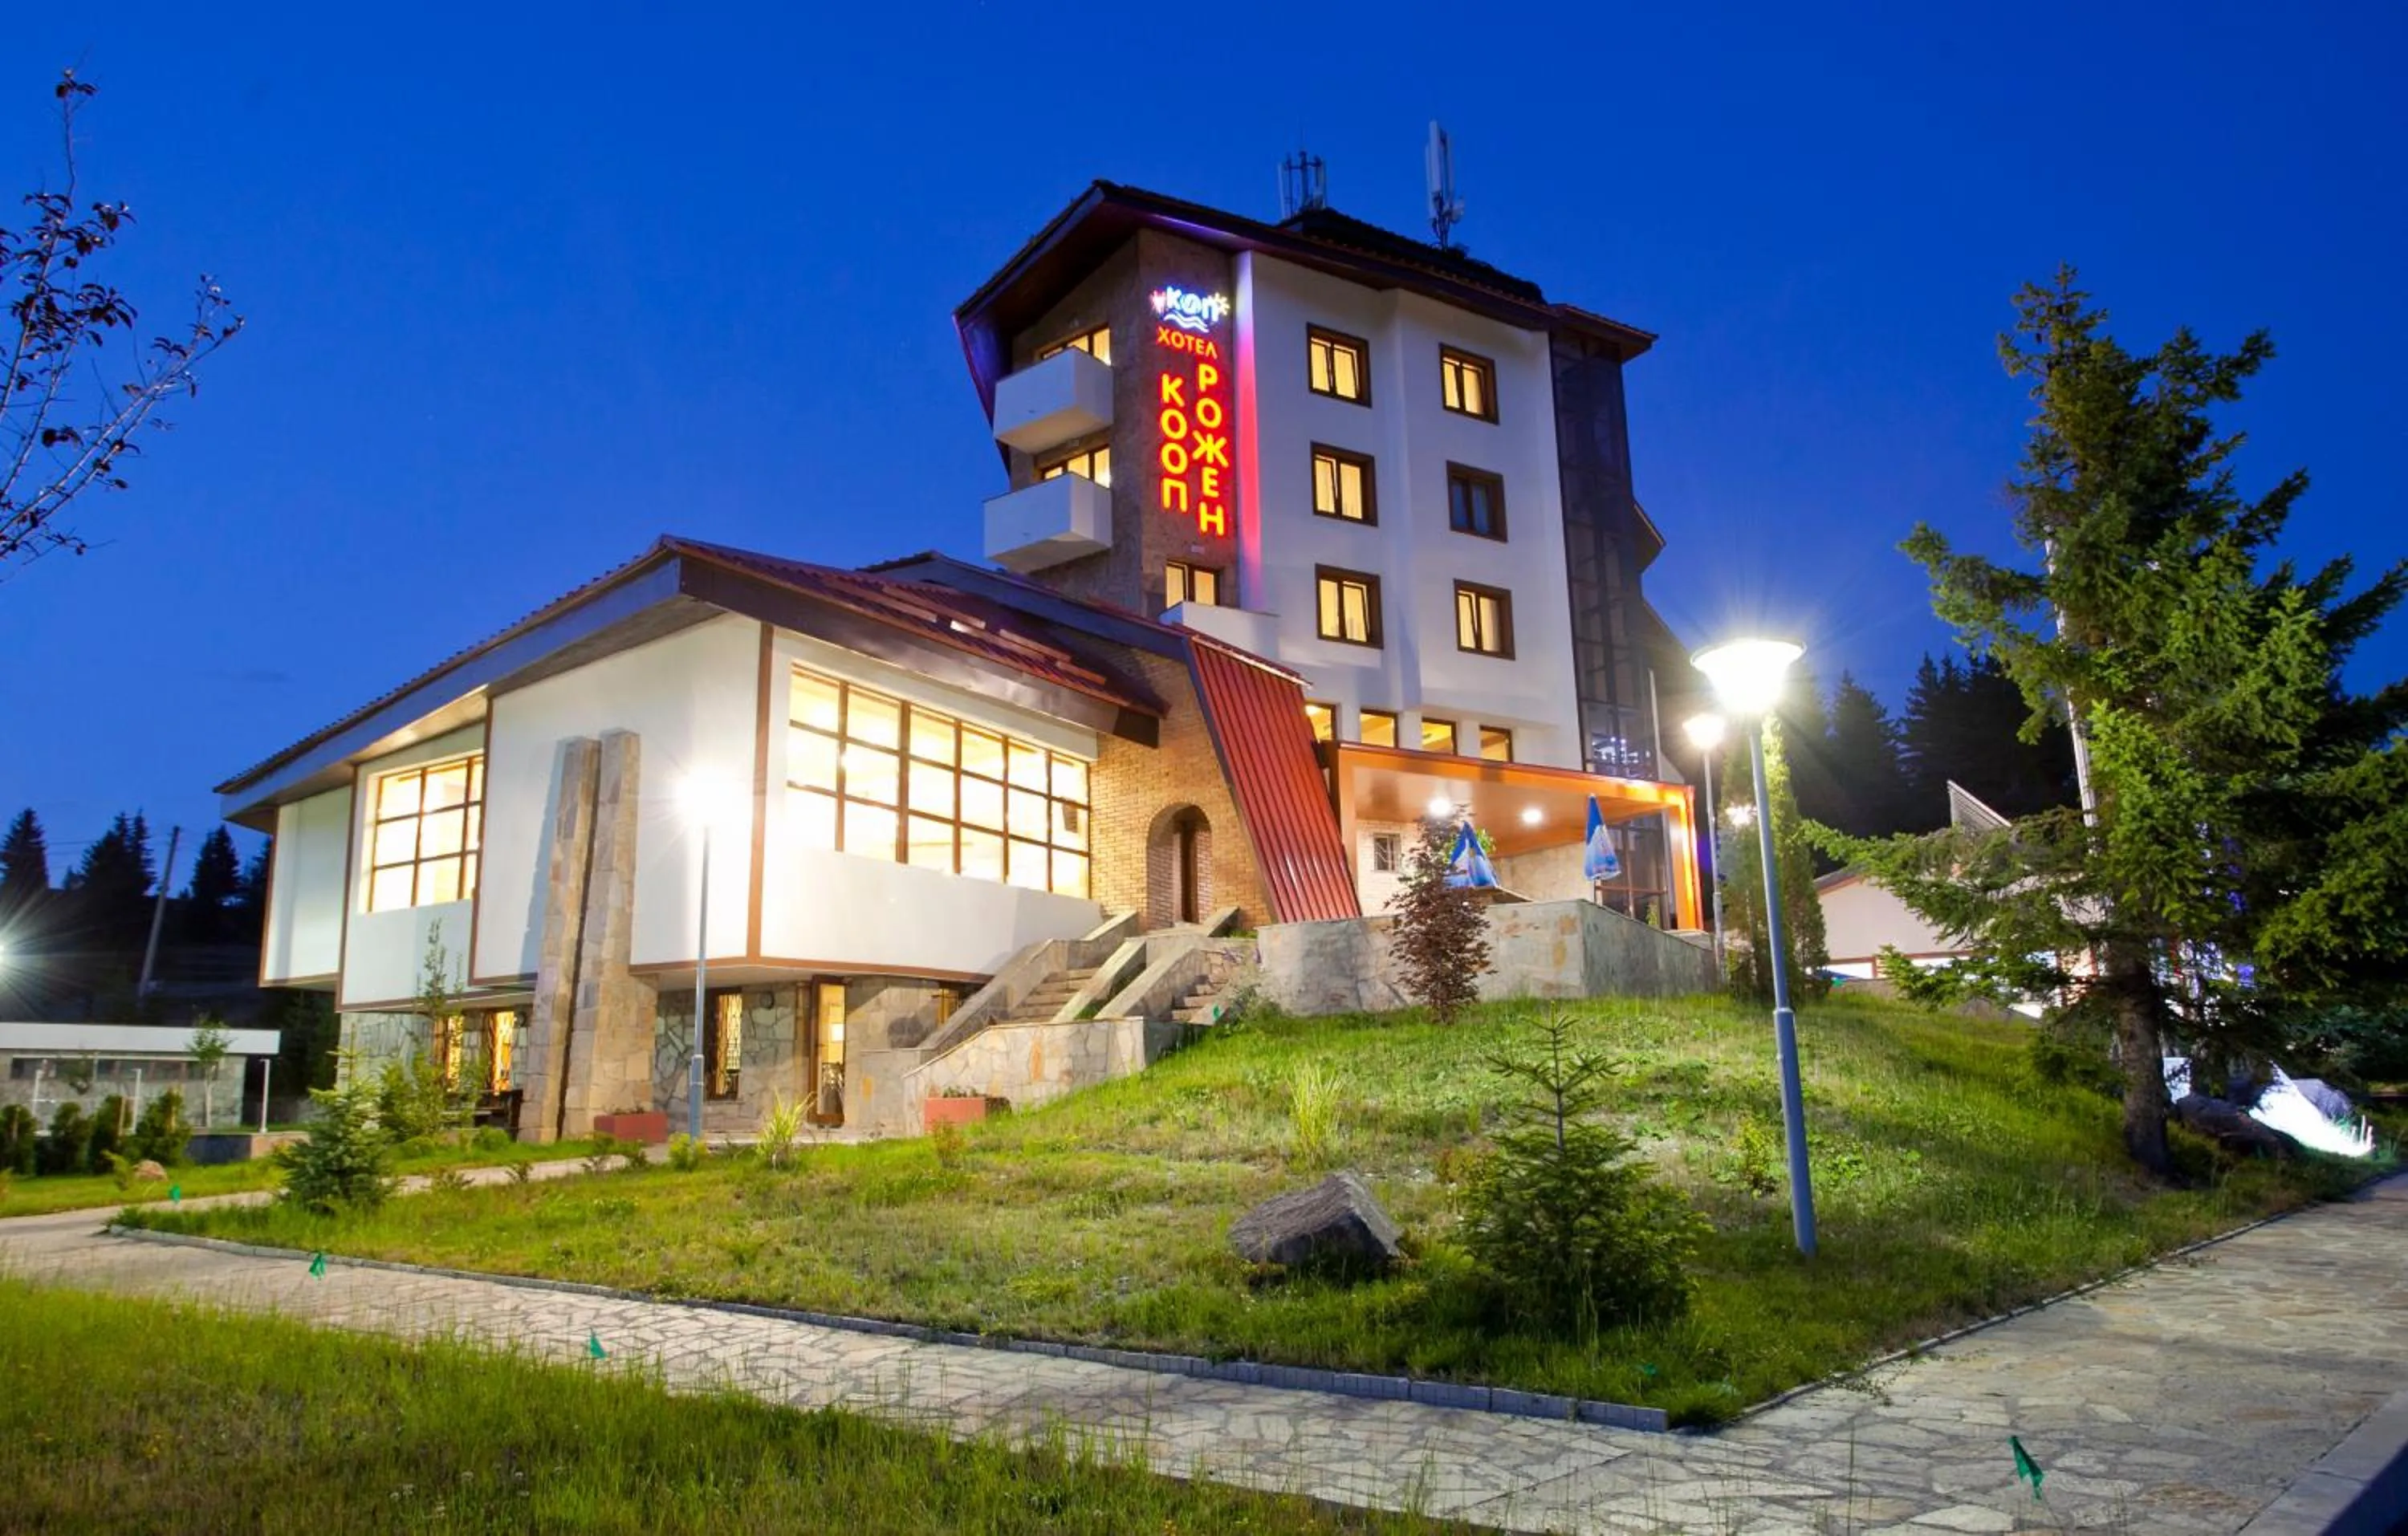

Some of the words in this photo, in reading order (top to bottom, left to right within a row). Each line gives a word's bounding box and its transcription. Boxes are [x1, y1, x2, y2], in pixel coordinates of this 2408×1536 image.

[1157, 327, 1218, 360] ХОТЕЛ
[1161, 373, 1188, 513] КООП
[1193, 364, 1229, 536] РОЖЕН
